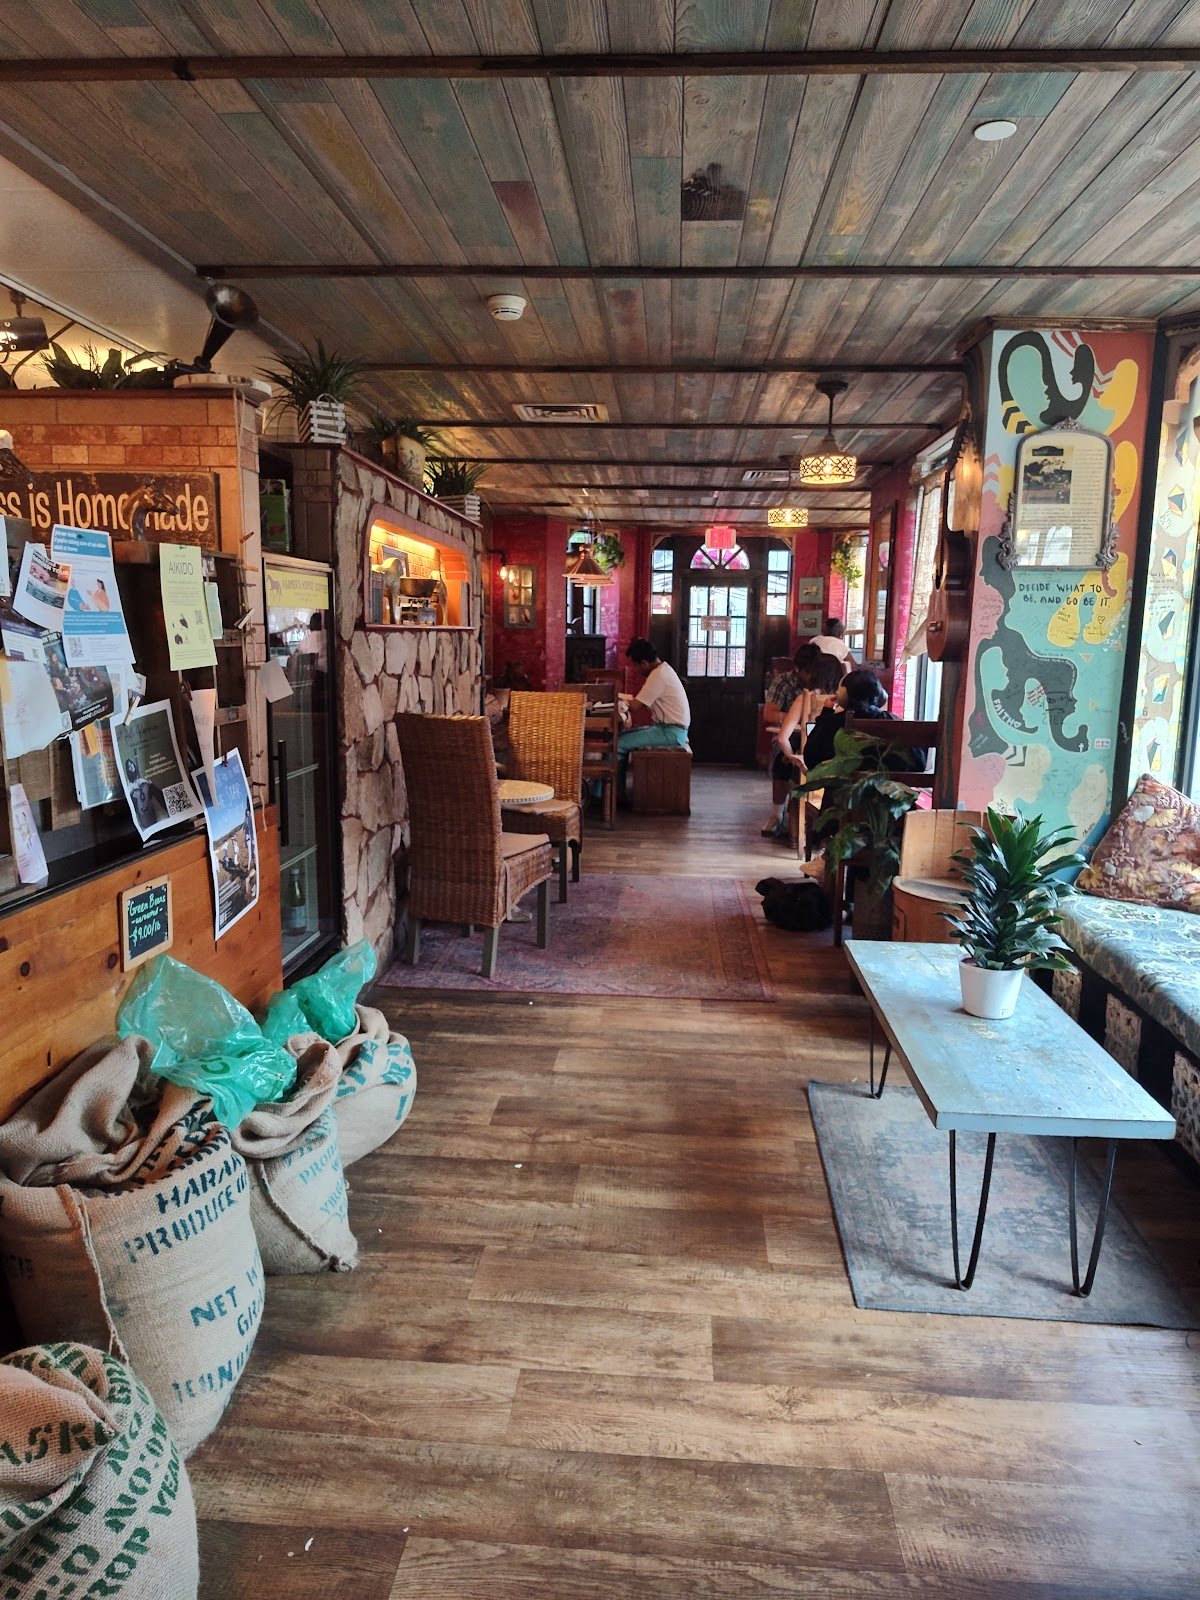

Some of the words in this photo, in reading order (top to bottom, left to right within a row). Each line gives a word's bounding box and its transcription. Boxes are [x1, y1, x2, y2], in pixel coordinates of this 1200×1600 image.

[28, 483, 51, 528] is
[168, 561, 194, 576] AIKIDO
[1019, 583, 1050, 592] DECIDE
[1056, 583, 1086, 593] WHAT
[1090, 583, 1102, 593] TO
[1040, 596, 1061, 605] AND
[1066, 596, 1078, 606] GO
[1083, 597, 1095, 606] BE
[993, 698, 1015, 727] FAITH
[129, 900, 149, 917] Green
[149, 893, 166, 909] Beans
[190, 1285, 237, 1328] NET
[80, 1526, 151, 1600] ROP
